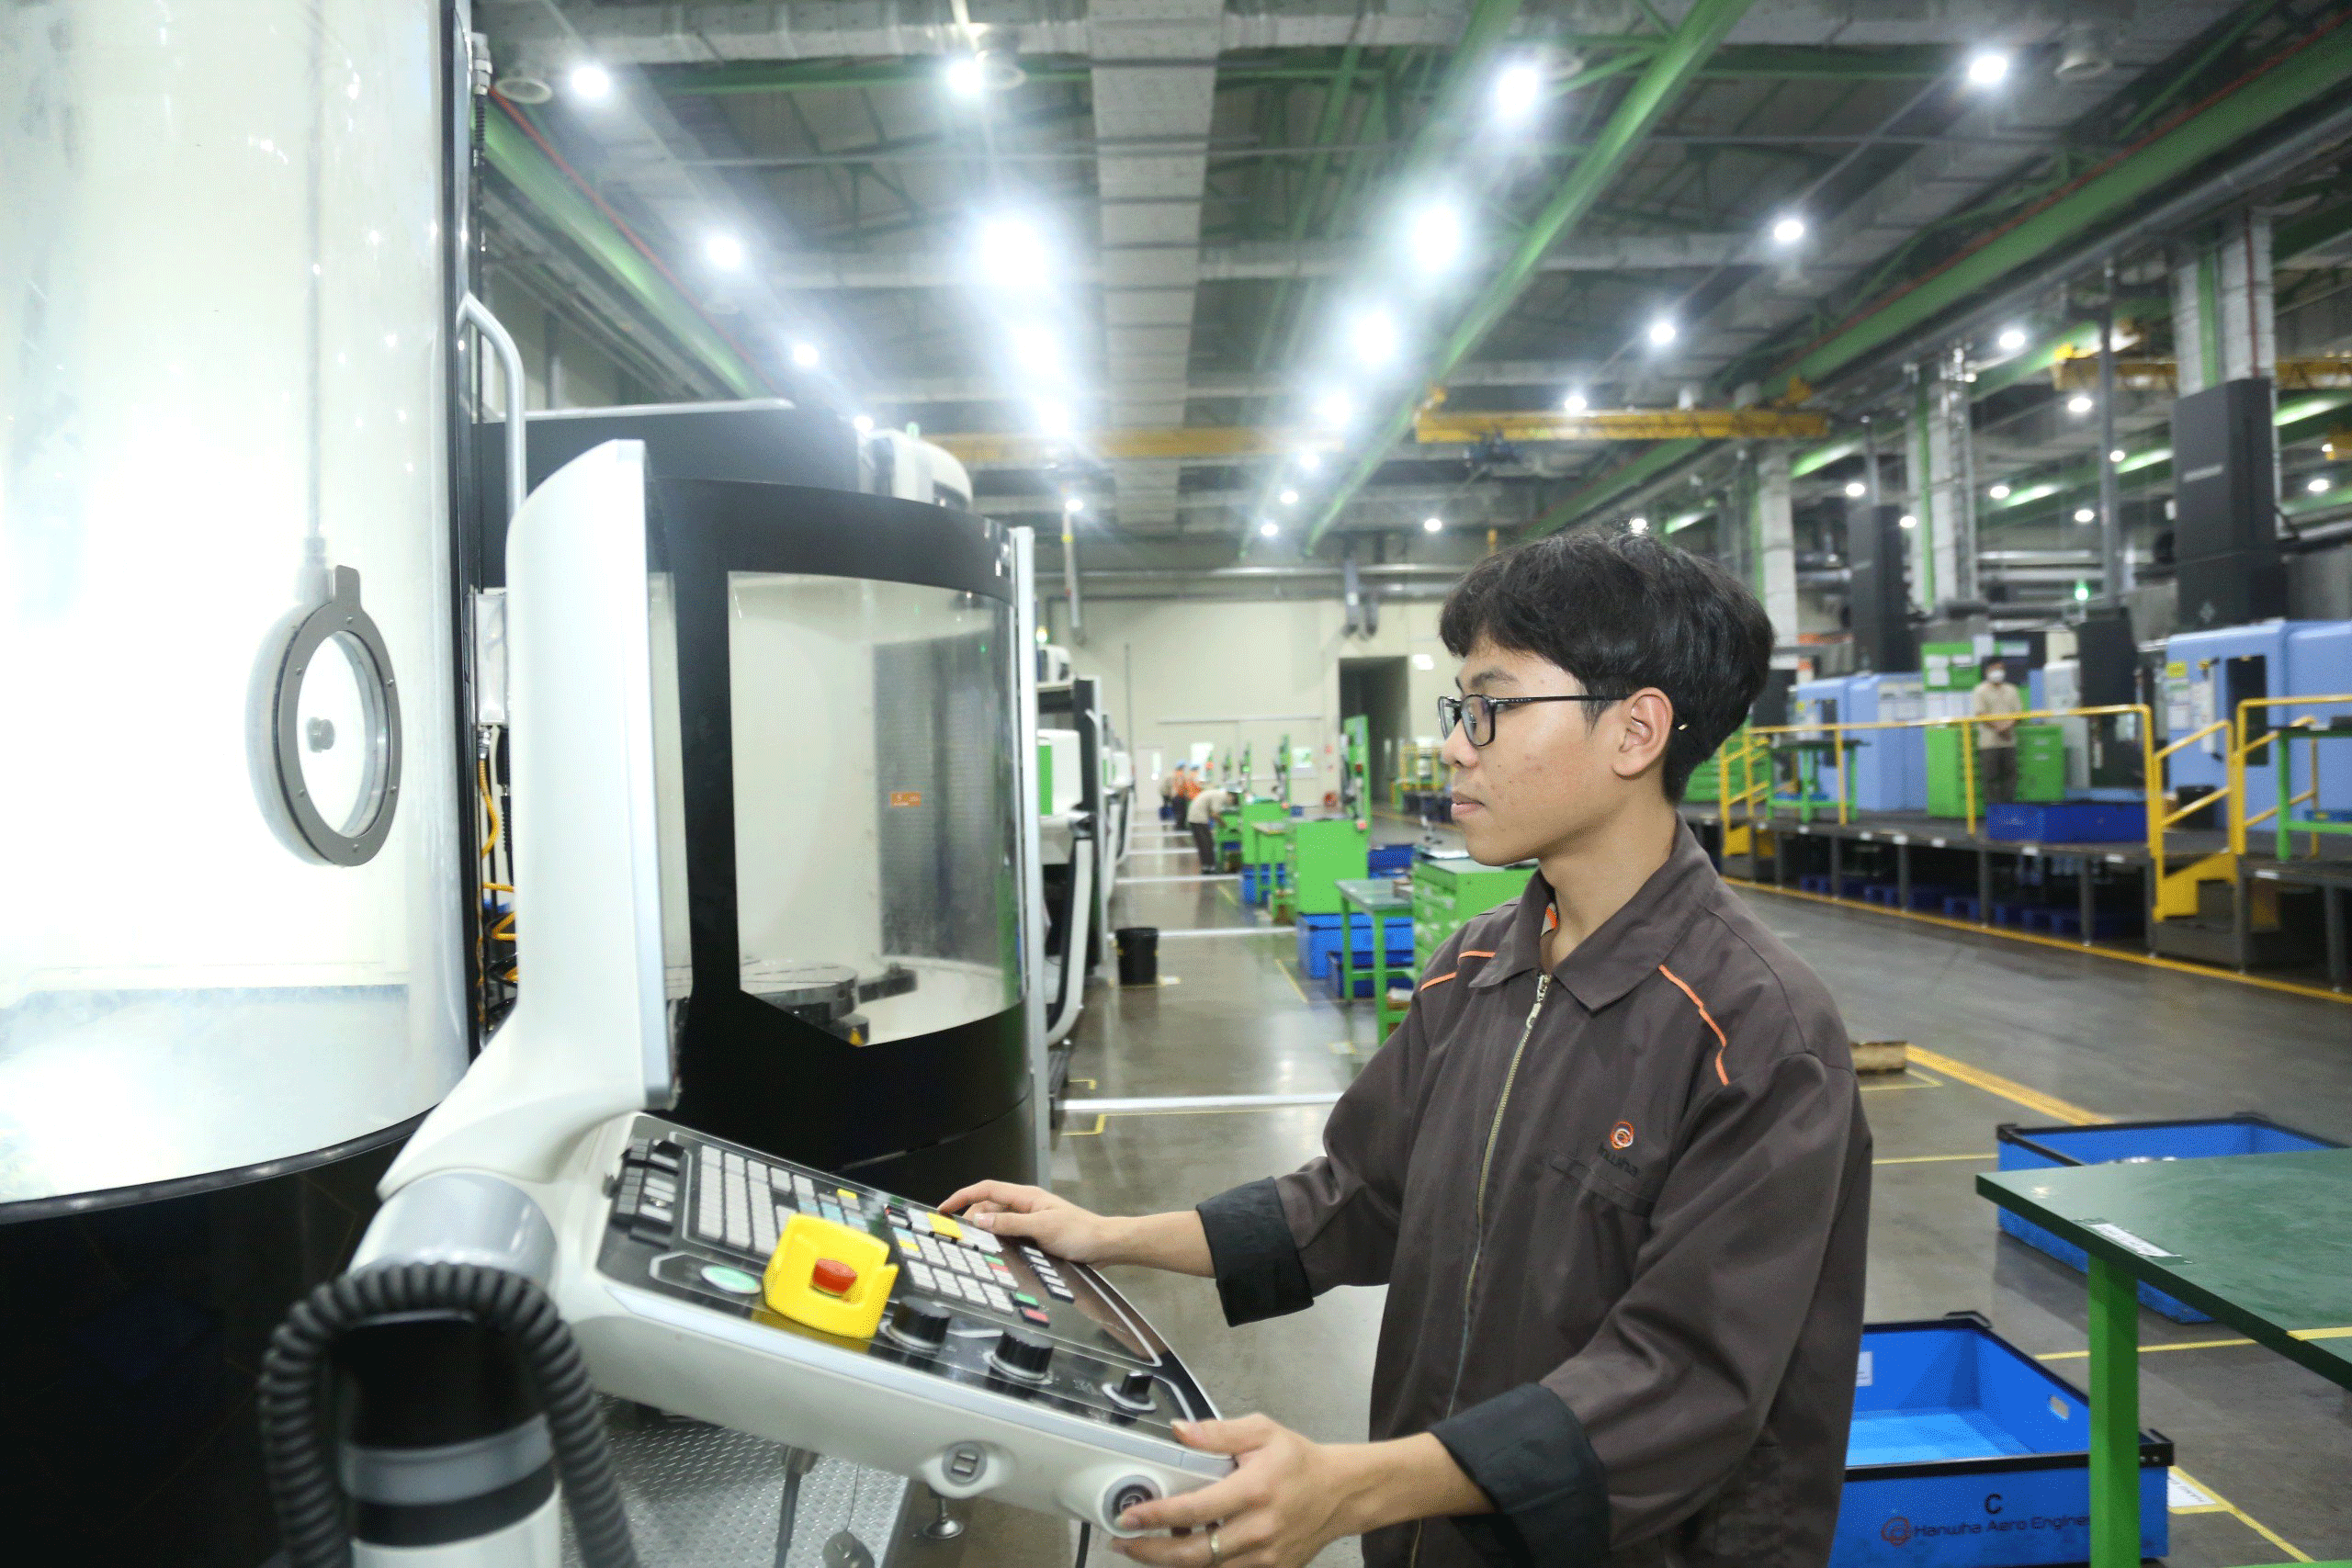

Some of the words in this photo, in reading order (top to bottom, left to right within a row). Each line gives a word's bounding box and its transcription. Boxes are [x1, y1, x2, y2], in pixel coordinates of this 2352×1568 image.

[1984, 1493, 2004, 1515] C
[1913, 1523, 1982, 1538] Hanwha
[1985, 1519, 2028, 1533] Aero
